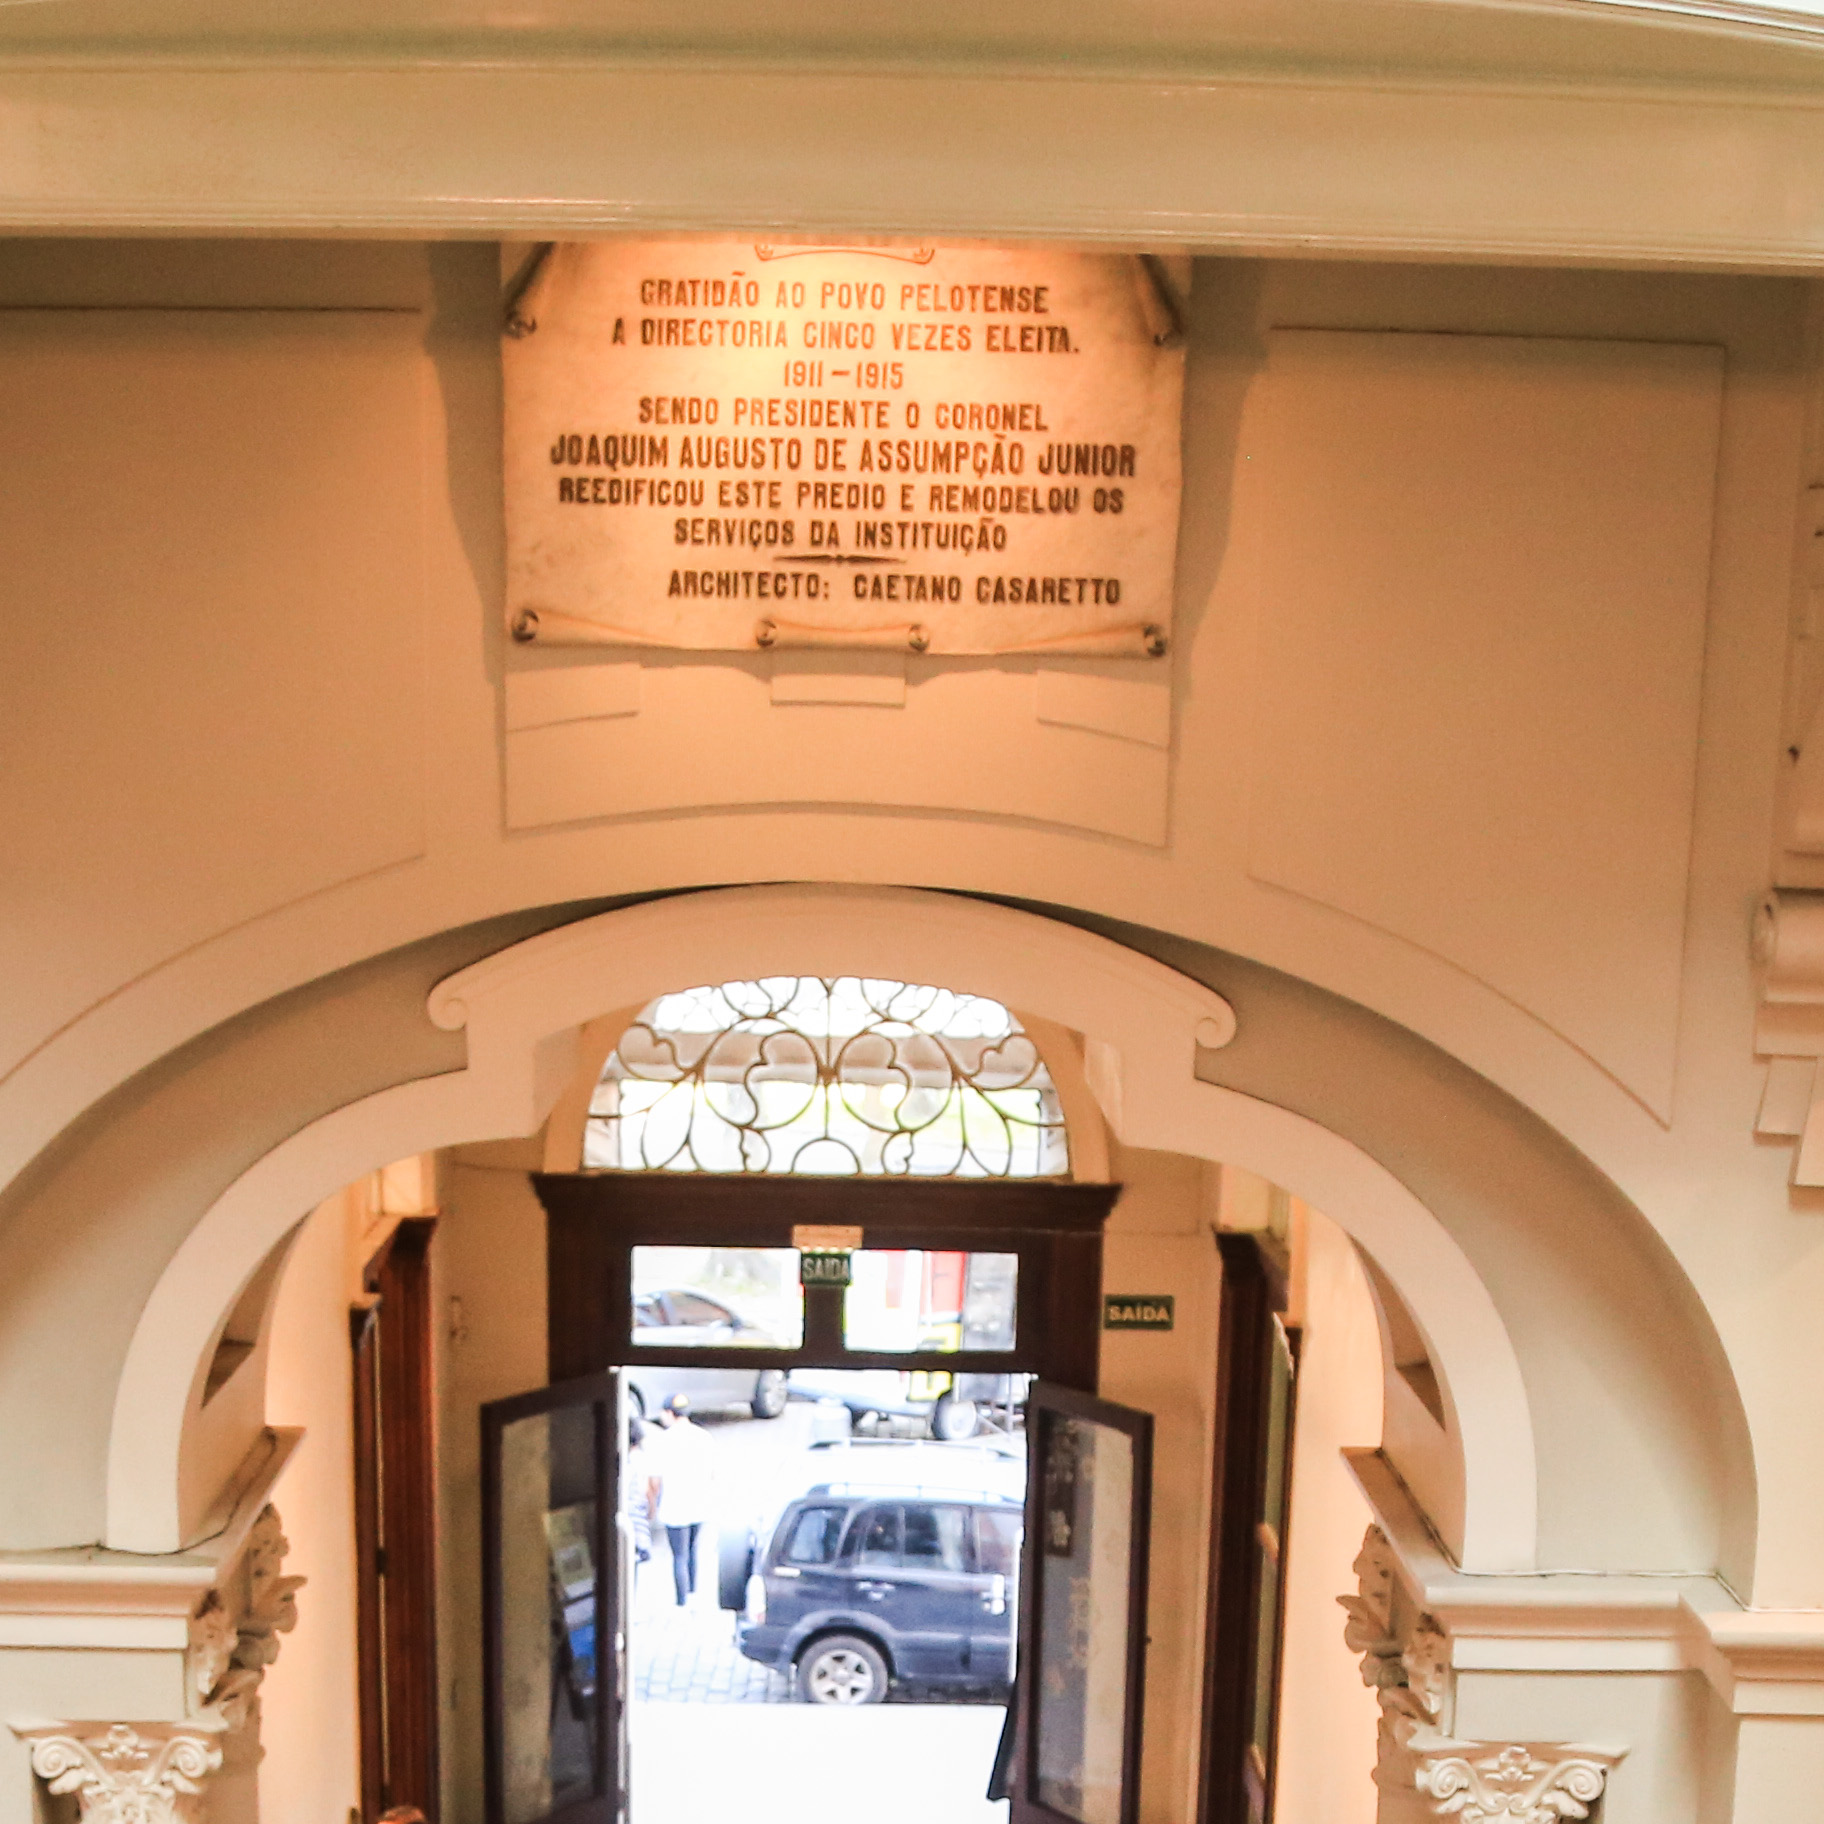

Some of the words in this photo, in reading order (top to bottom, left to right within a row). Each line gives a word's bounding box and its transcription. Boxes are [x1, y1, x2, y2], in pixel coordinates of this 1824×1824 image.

[641, 271, 760, 307] GRATIDÃO
[776, 280, 805, 309] AO
[821, 281, 885, 310] POVO
[900, 283, 1049, 313] PELOTENSE
[612, 317, 625, 346] A
[641, 318, 788, 348] DIRECTORIA
[804, 320, 874, 350] CINCO
[892, 322, 972, 352] VEZES
[986, 324, 1079, 354] ELEITA.
[639, 396, 719, 426] SENDO
[734, 398, 890, 429] PRESIDENTE
[906, 402, 919, 429] O
[935, 402, 1048, 431] CORONEL
[550, 434, 668, 471] JOAQUIM
[679, 436, 802, 470] AUGUSTO
[815, 438, 846, 472] DE
[860, 433, 1024, 481] ASSUMPÇÃO
[1038, 443, 1136, 477] JUNIOR
[559, 477, 705, 507] REEDIFICOU
[718, 481, 782, 508] ESTE
[797, 482, 885, 511] PREDIO
[901, 484, 914, 512] E
[930, 484, 1078, 514] REMODELOU
[1093, 487, 1123, 514] OS
[675, 518, 795, 551] SERVIÇOS
[810, 520, 839, 547] DA
[855, 517, 1007, 557] INSTITUIÇÃO
[668, 570, 829, 600] ARCHITECTO:
[854, 574, 961, 601] CAETANO
[977, 577, 1120, 605] CASARETTO
